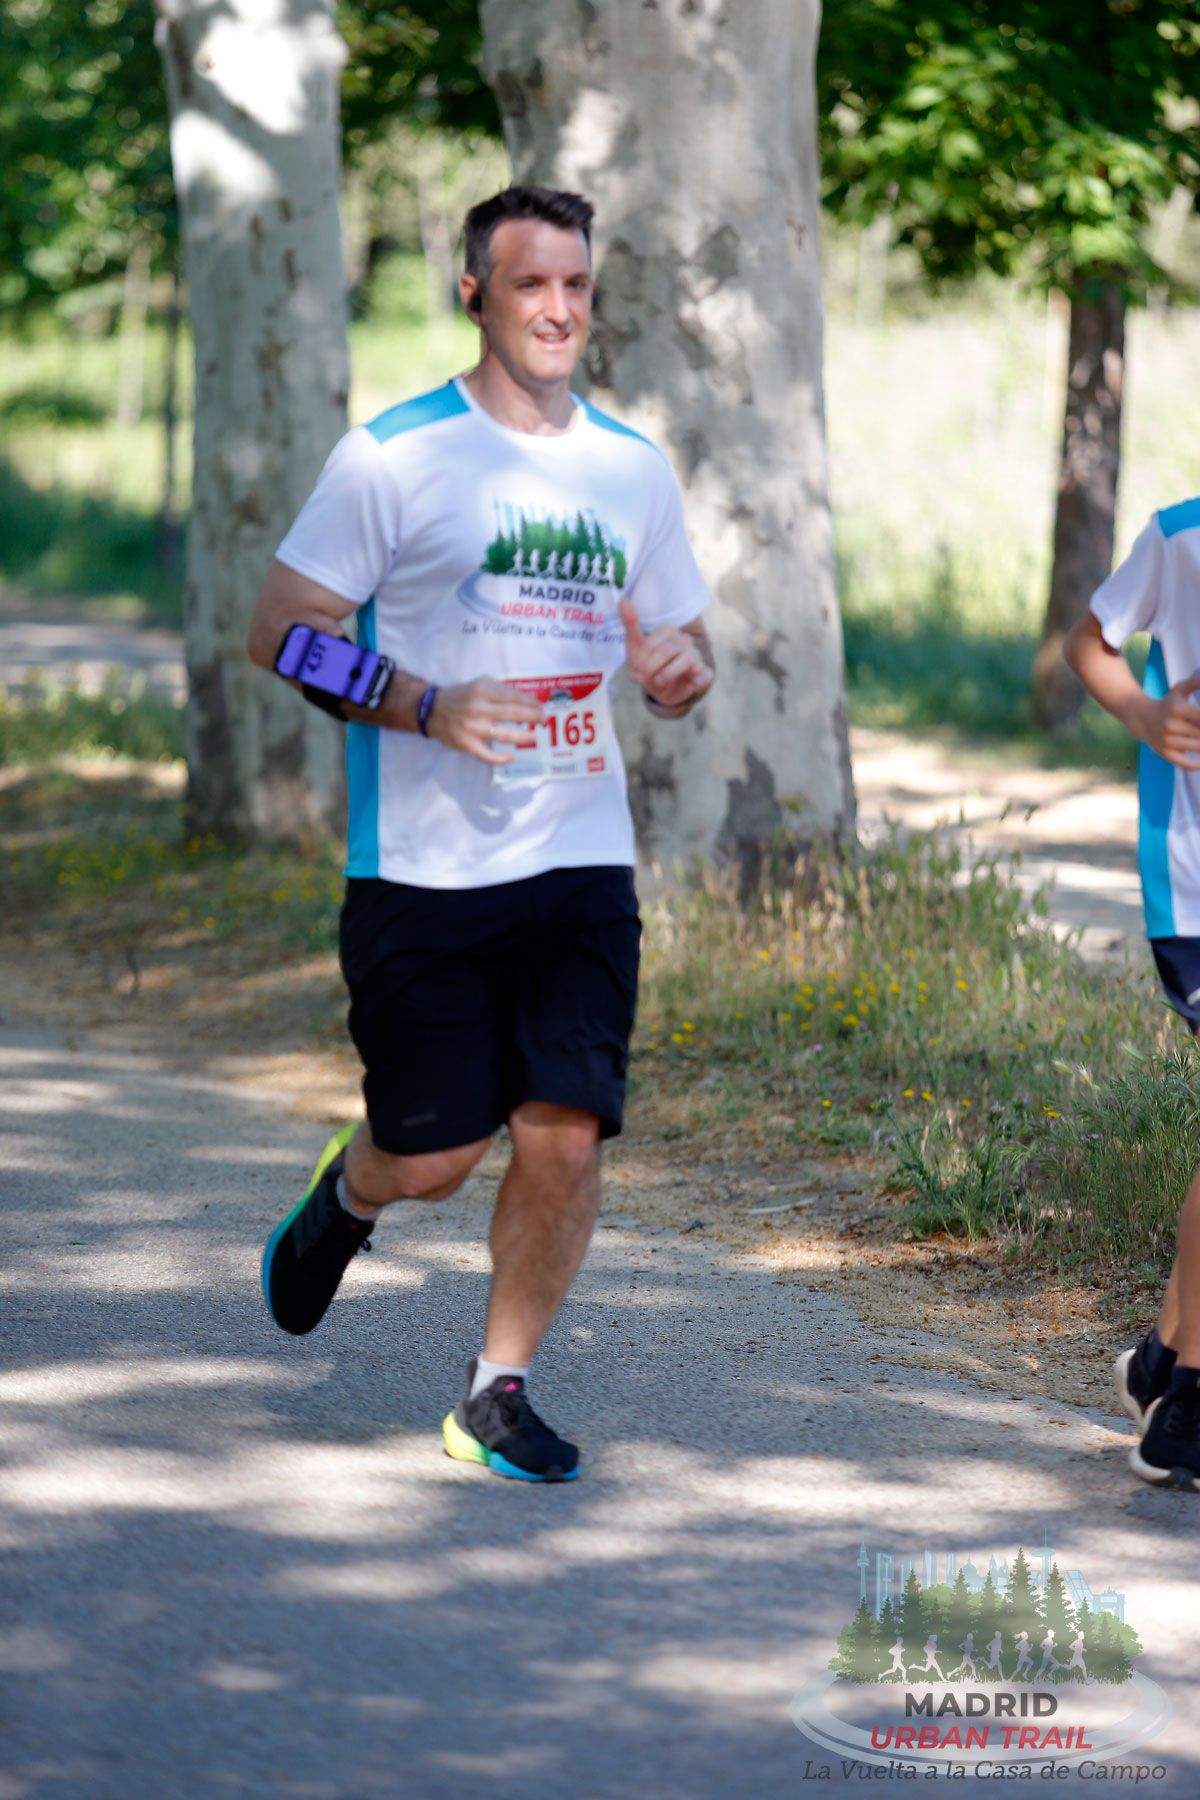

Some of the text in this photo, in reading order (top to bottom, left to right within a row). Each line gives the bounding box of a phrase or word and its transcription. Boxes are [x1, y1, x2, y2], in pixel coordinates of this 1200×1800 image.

[519, 584, 596, 605] MADRID
[501, 602, 558, 619] URBAN
[483, 622, 523, 636] Vuelta
[551, 625, 577, 640] Casa
